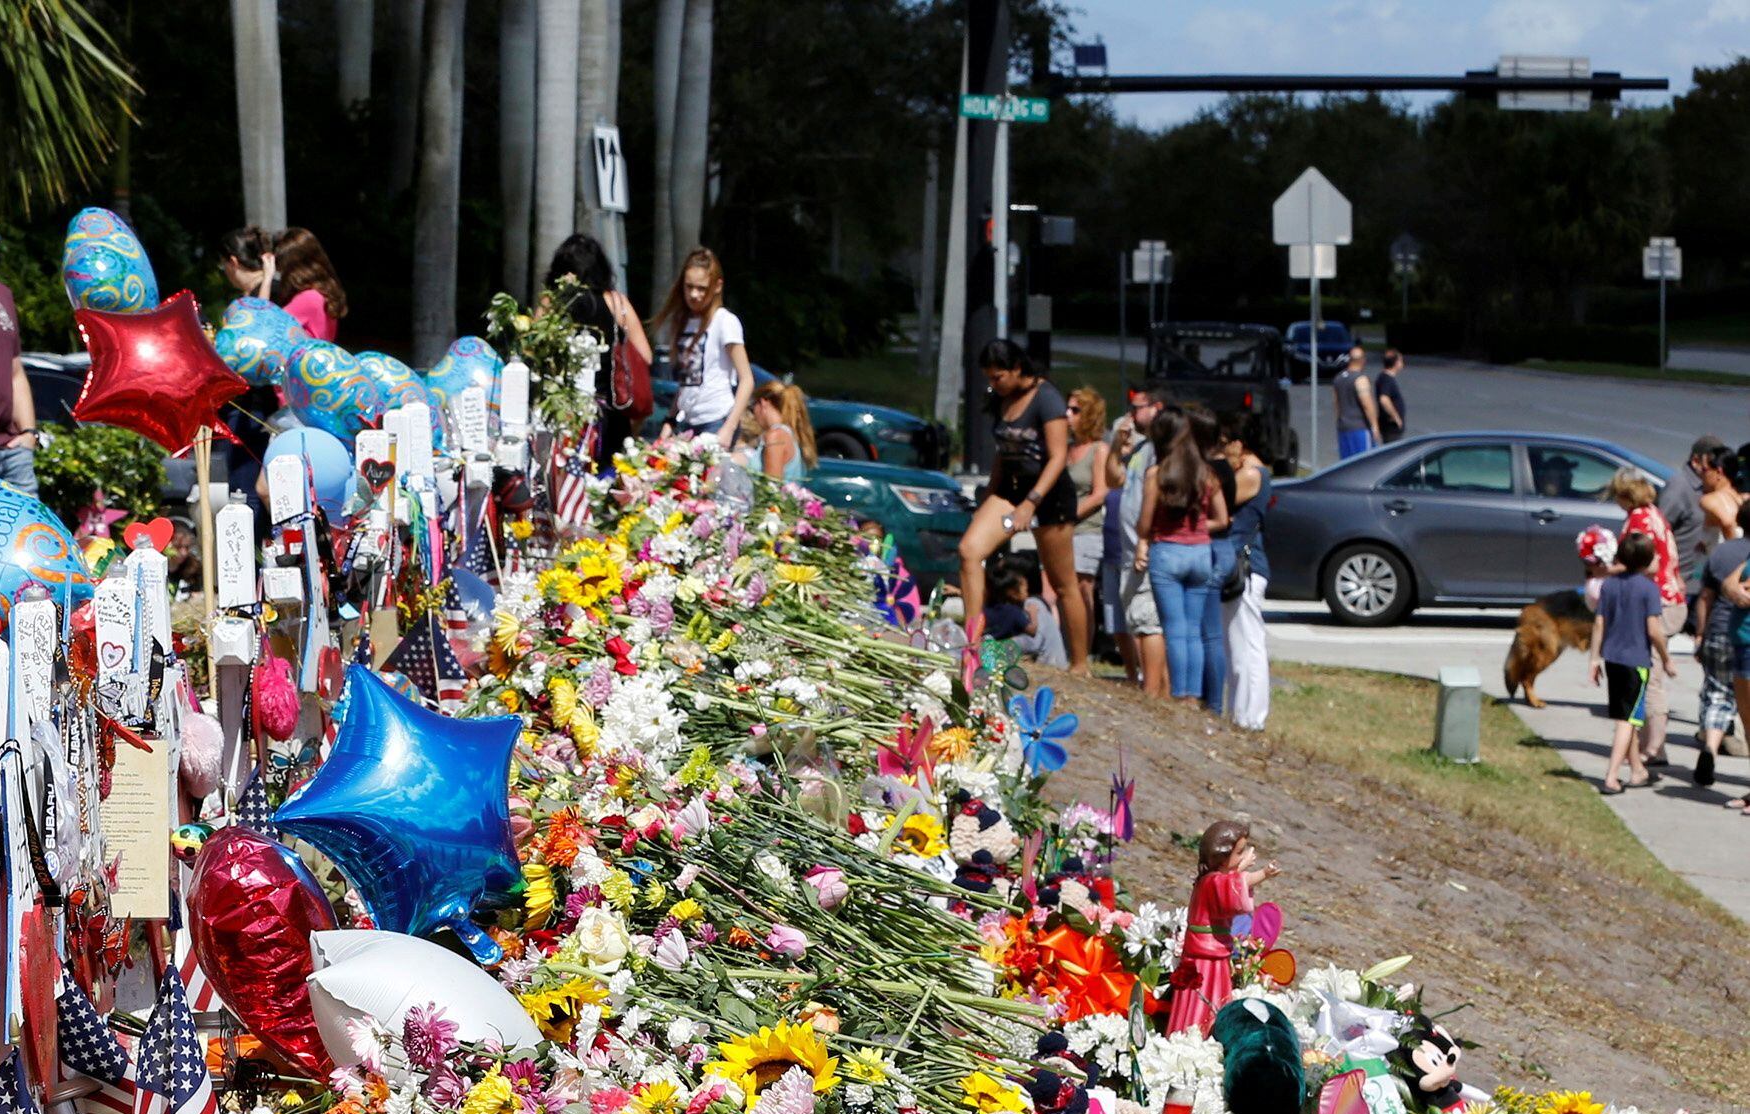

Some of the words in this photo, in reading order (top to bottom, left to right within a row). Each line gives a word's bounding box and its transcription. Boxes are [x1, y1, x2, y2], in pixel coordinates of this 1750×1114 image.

[963, 97, 1029, 118] HOLMERG
[72, 717, 80, 767] SUBARU
[45, 783, 56, 849] SUBARU
